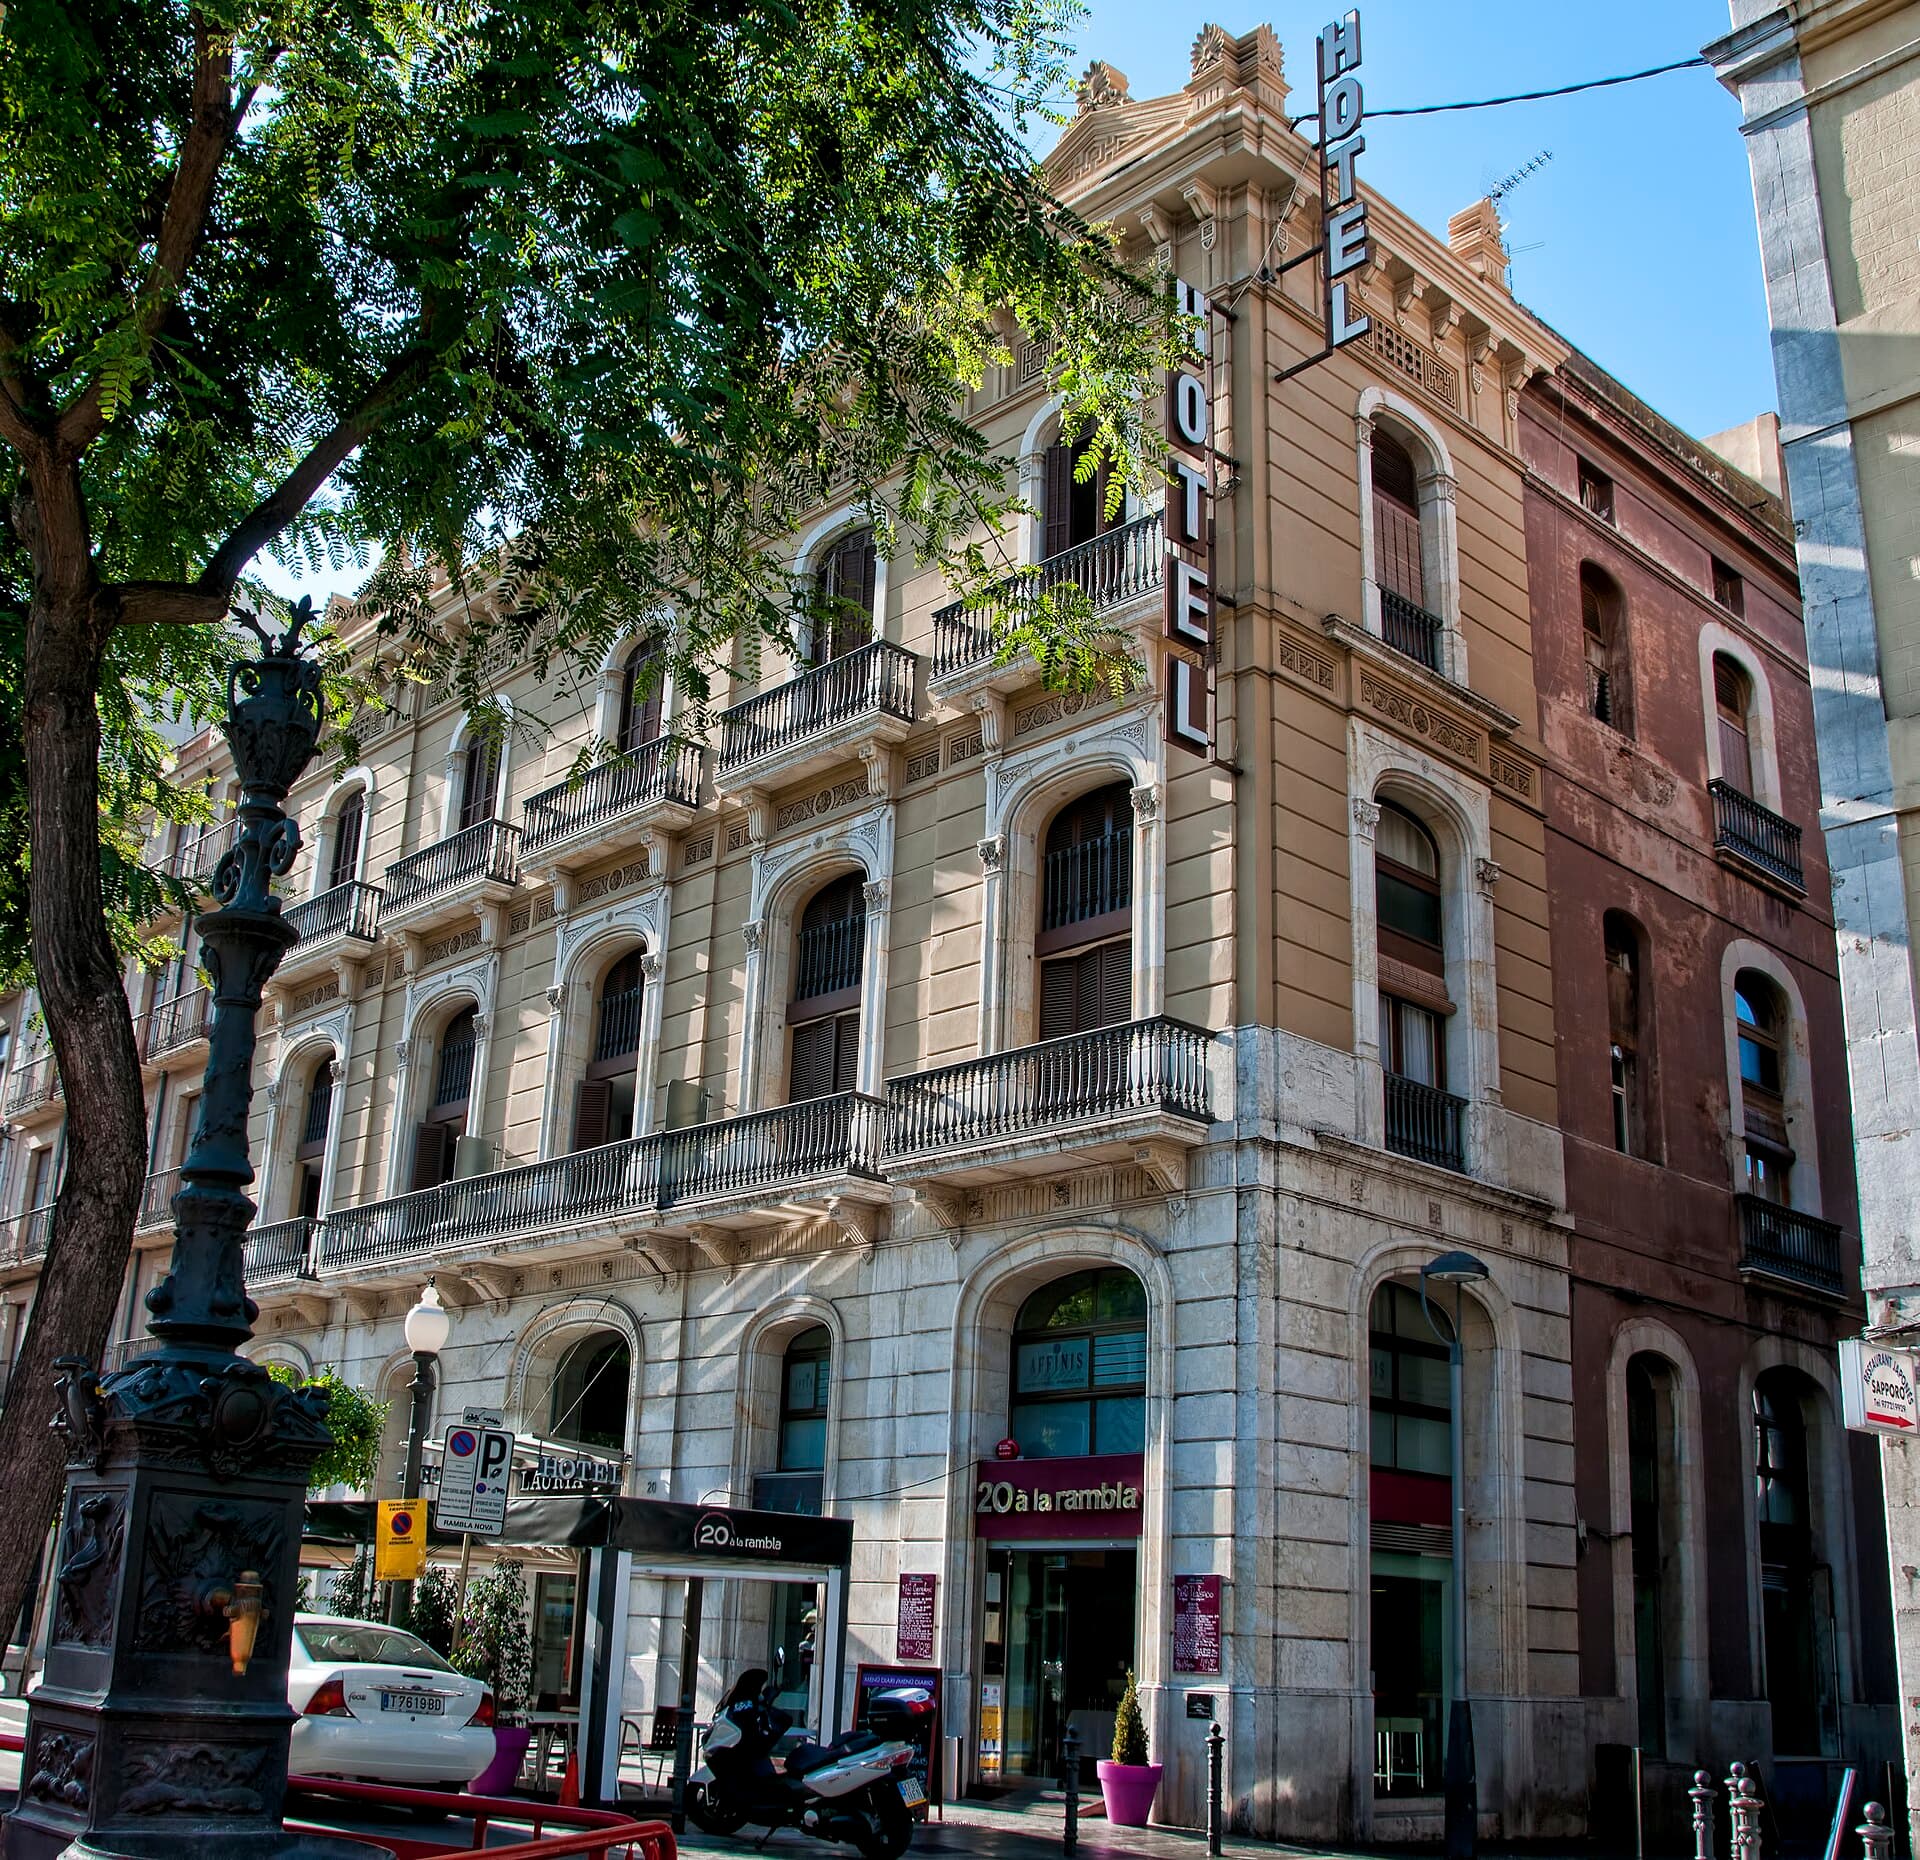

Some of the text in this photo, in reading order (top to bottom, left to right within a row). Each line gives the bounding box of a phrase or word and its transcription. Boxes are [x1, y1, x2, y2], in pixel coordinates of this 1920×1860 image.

[1321, 8, 1371, 348] HOTEL
[1176, 277, 1208, 746] HOTEL
[1031, 1351, 1083, 1375] AFFINIS
[1863, 1352, 1892, 1385] RESTAURANT
[1871, 1379, 1905, 1400] SAPPORO
[480, 1433, 507, 1479] P
[538, 1456, 624, 1485] HOTEL
[647, 1482, 657, 1494] 20
[976, 1481, 1014, 1513] 20
[1033, 1488, 1052, 1512] la
[1055, 1481, 1139, 1512] rambla
[443, 1519, 494, 1532] RAMBLA NOVA
[700, 1524, 729, 1545] 20
[736, 1536, 743, 1547] la
[745, 1535, 782, 1550] rambla
